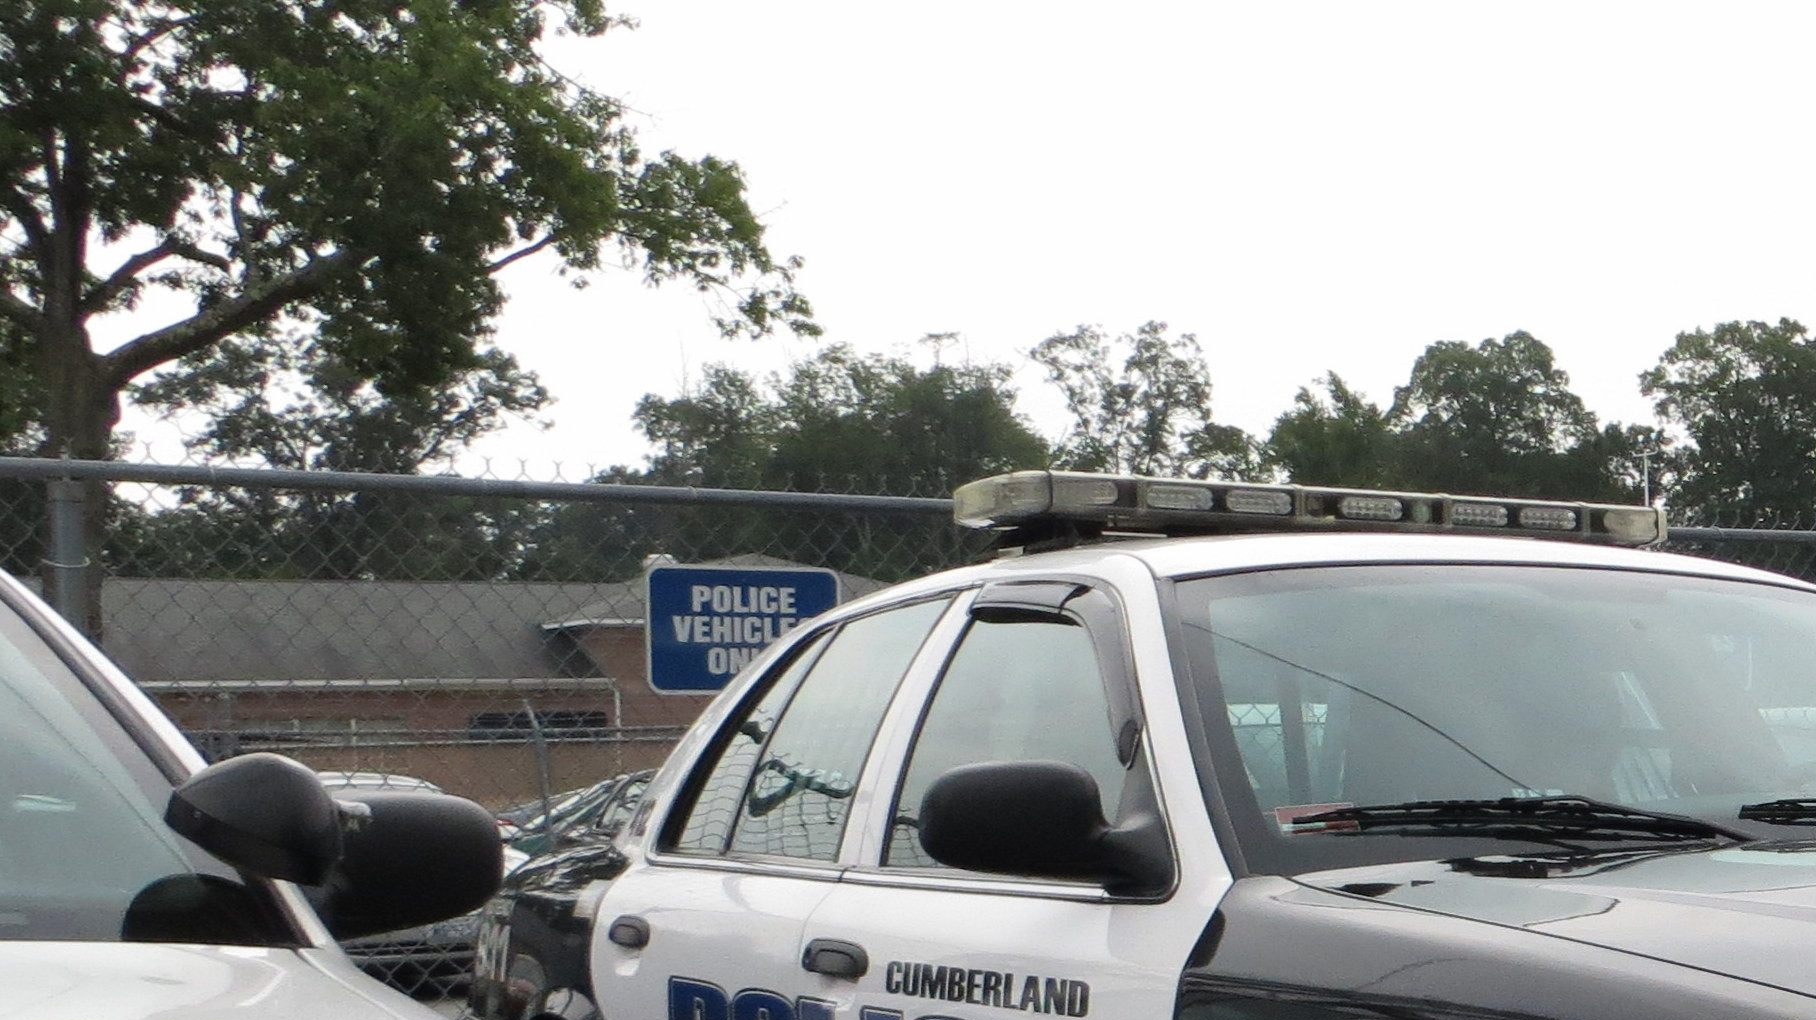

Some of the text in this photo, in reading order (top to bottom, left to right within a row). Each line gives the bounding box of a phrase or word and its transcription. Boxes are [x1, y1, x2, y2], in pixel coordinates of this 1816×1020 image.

[692, 585, 797, 614] POLICE
[672, 615, 811, 644] VEHICLE
[708, 647, 764, 675] ON
[885, 961, 1090, 1018] CUMBERLAND
